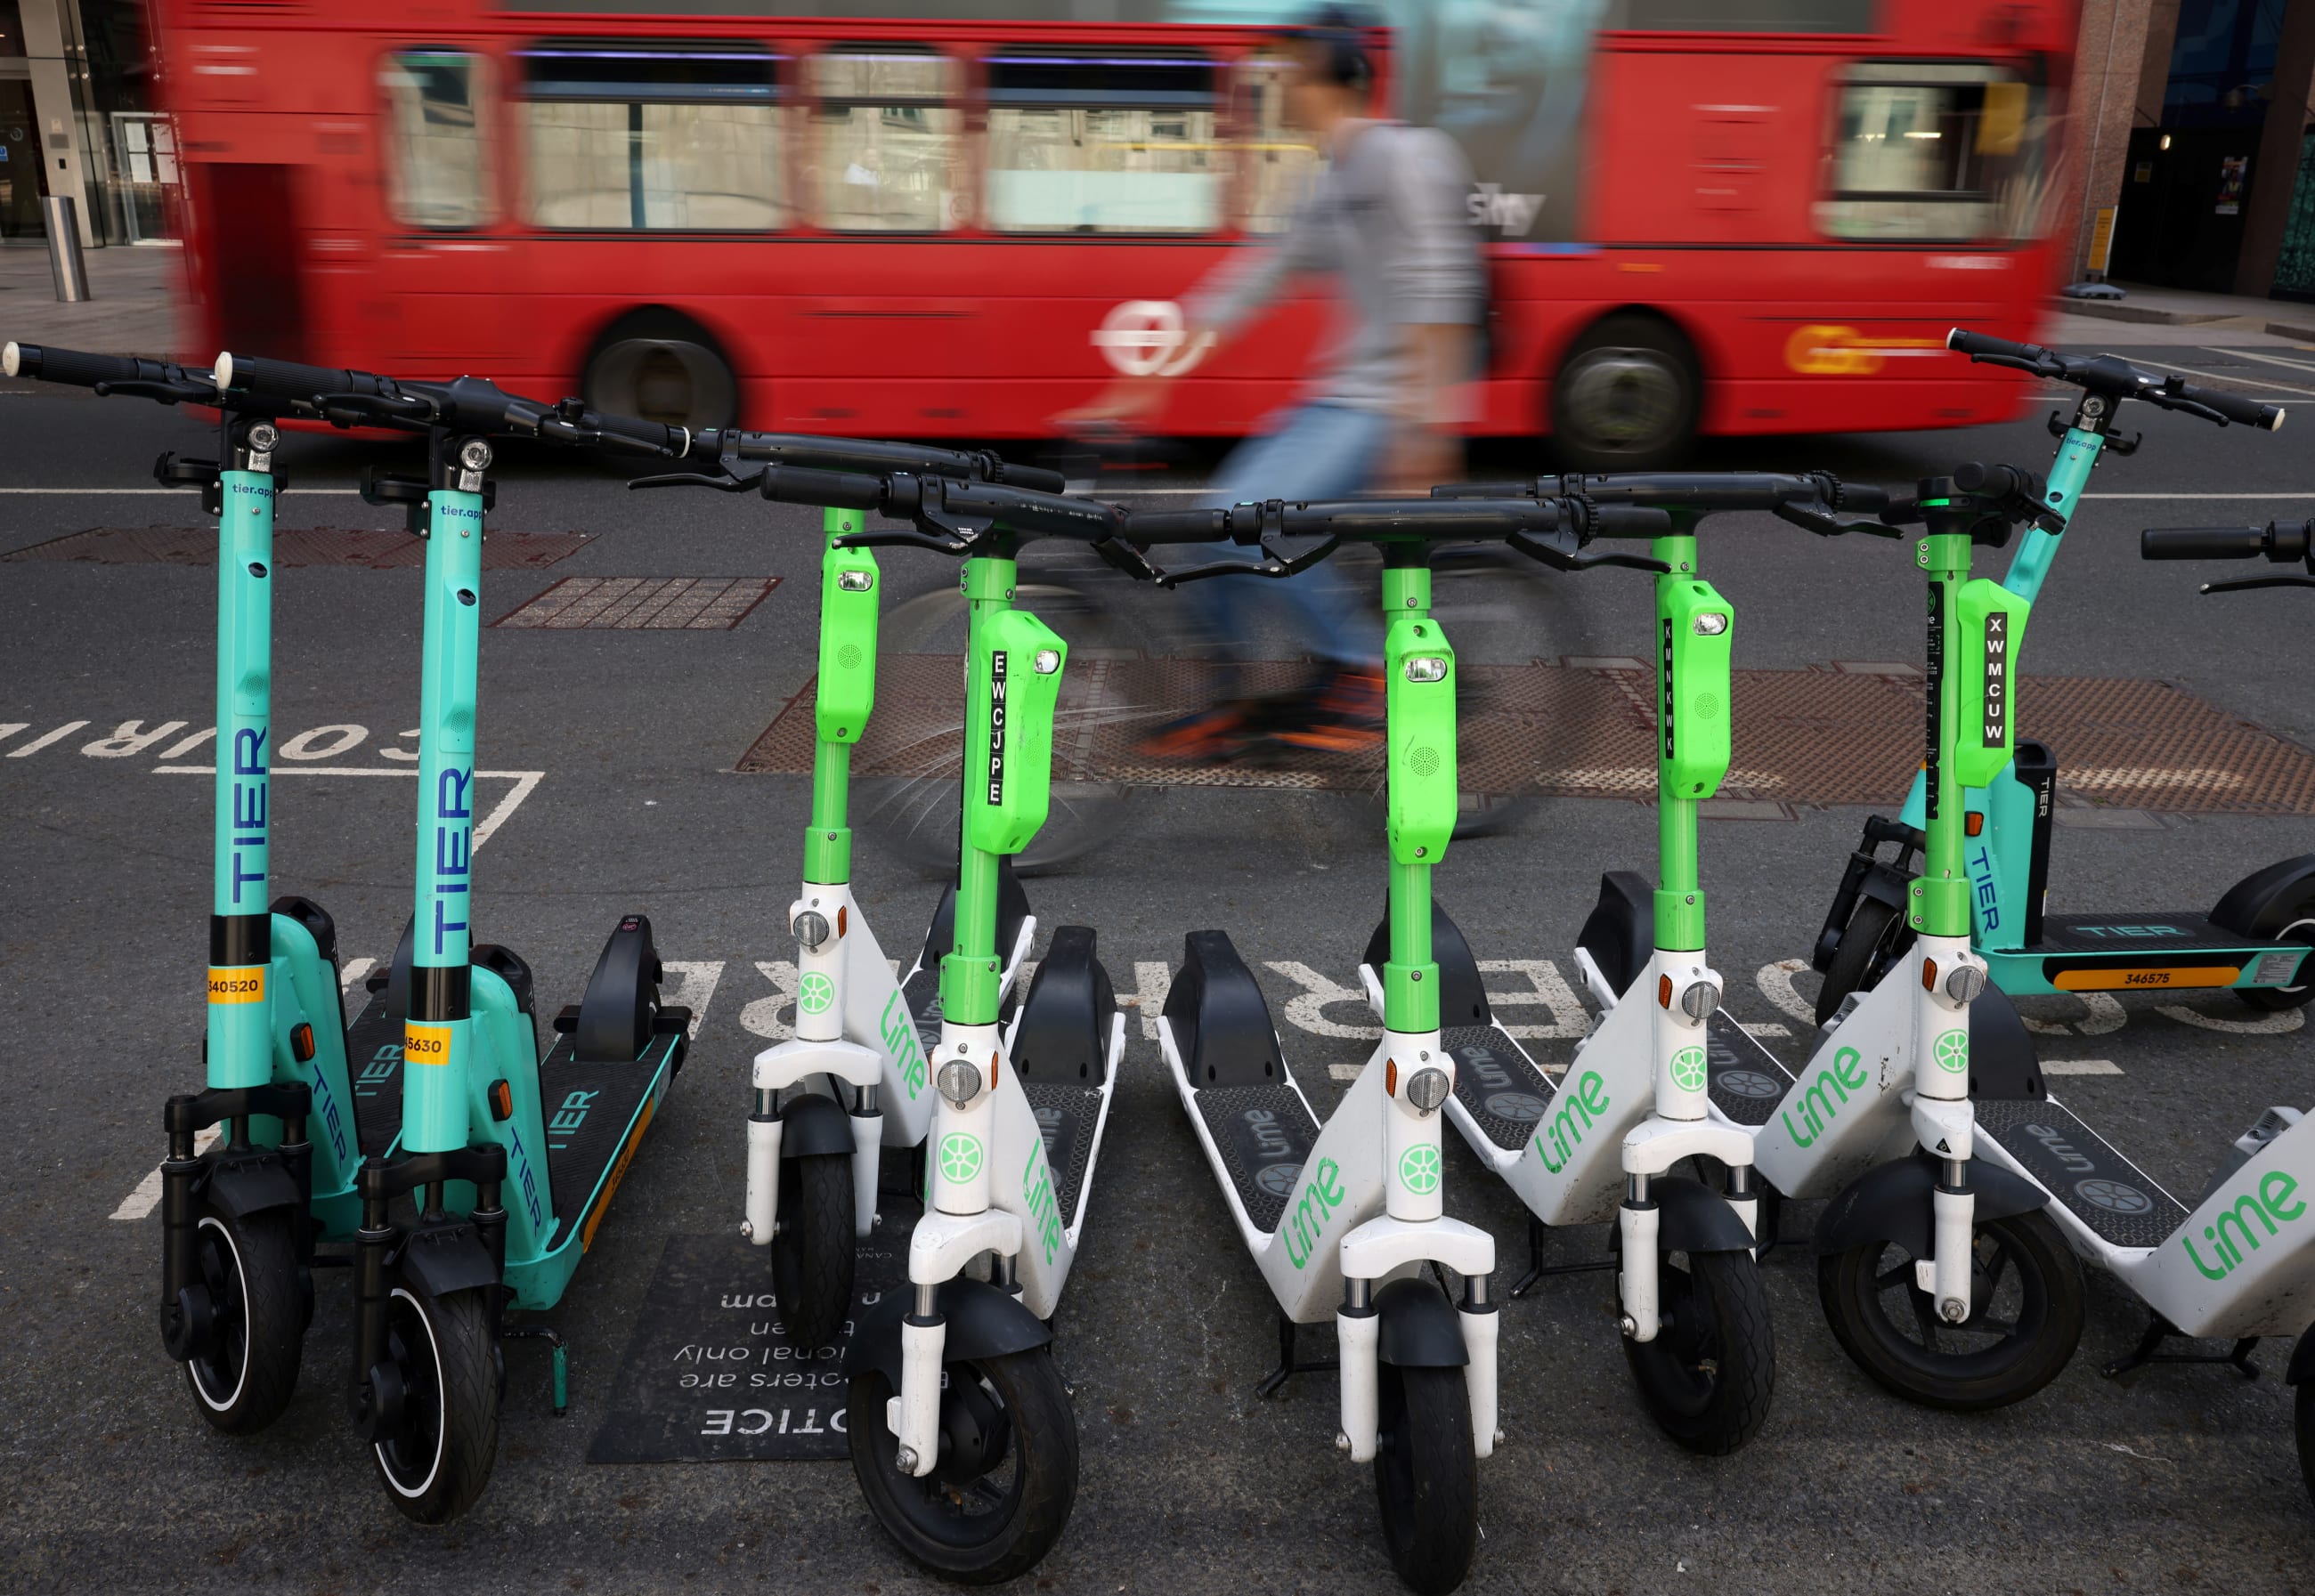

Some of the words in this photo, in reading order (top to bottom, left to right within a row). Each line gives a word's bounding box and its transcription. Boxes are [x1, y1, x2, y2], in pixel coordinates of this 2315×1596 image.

[2066, 437, 2097, 451] tier.app
[233, 726, 267, 903] TIER
[2038, 777, 2050, 817] TIER
[435, 766, 471, 954] TIER
[1972, 847, 2000, 933] TIER
[2075, 926, 2187, 937] TIER
[2124, 973, 2171, 984] 346575
[881, 989, 924, 1100] Lime
[1461, 1047, 1512, 1089] Lime
[313, 1064, 346, 1171] TIER
[1245, 1109, 1290, 1157] Lime
[1535, 1071, 1610, 1174] Lime
[1782, 1046, 1868, 1148] Lime
[511, 1126, 541, 1238] TIER
[2025, 1123, 2095, 1172] Lime
[1024, 1138, 1060, 1266] Lime
[1282, 1157, 1345, 1270] Lime
[2182, 1171, 2307, 1281] Lime
[673, 1344, 750, 1365] only
[679, 1373, 736, 1388] are
